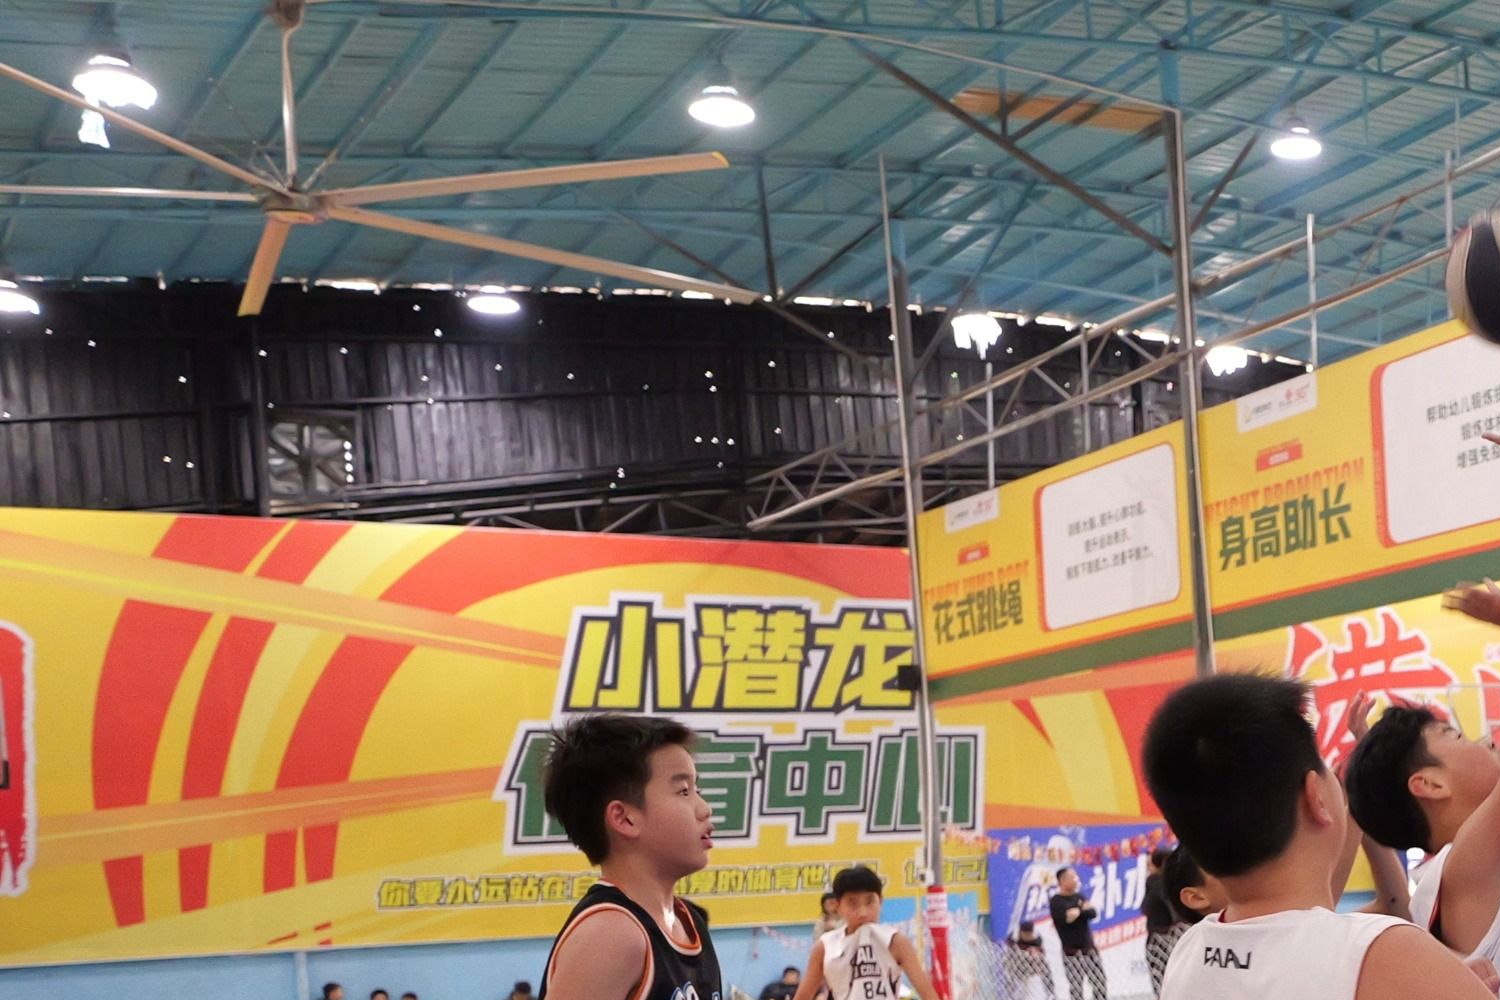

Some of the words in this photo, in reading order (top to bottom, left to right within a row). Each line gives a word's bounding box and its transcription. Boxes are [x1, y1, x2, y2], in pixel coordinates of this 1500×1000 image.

[1263, 457, 1365, 501] PROMOTION
[1219, 482, 1352, 571] 身高助长
[932, 579, 1023, 645] 花式跳绳
[562, 600, 917, 714] 小潜龙
[863, 980, 887, 1000] 84
